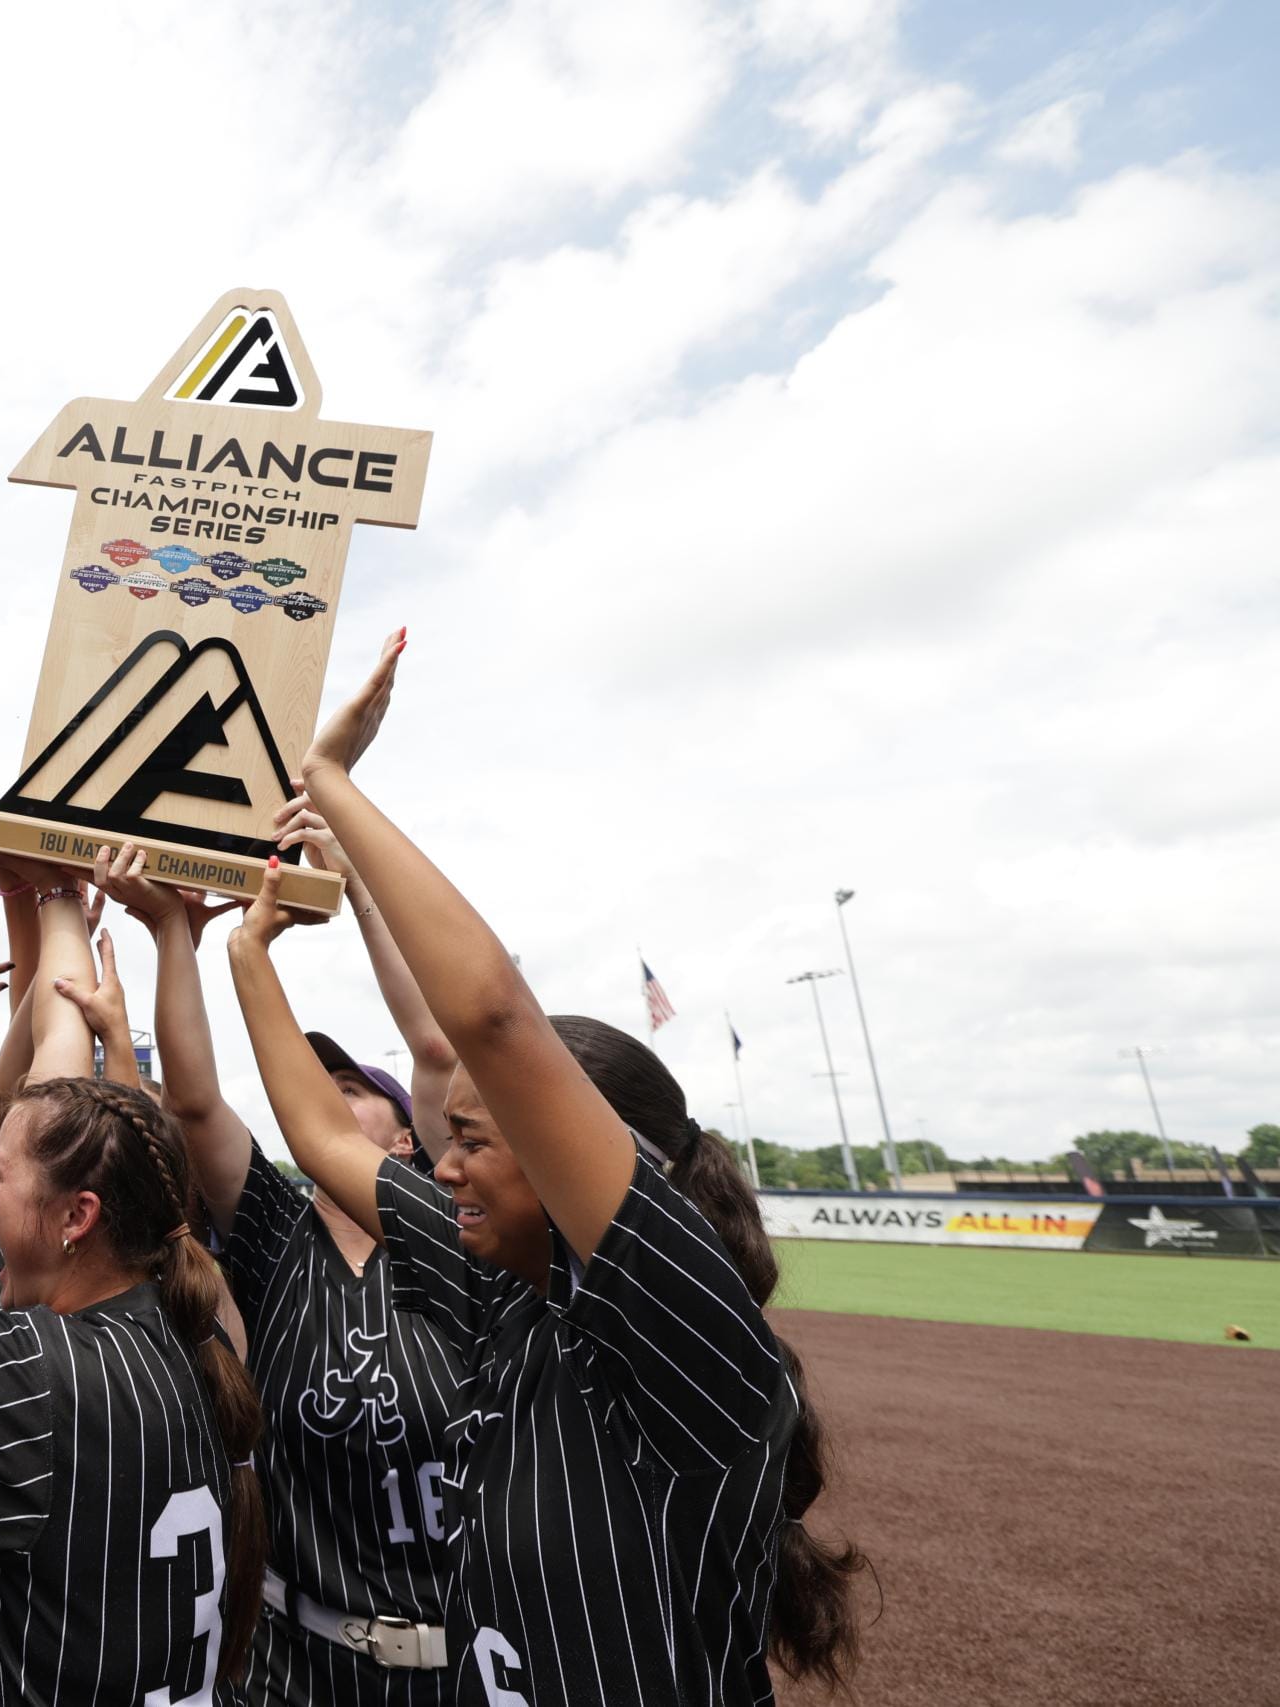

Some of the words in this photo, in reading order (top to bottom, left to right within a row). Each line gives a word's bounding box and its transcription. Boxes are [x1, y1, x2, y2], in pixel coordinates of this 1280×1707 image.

[57, 423, 398, 493] ALLIANCE
[134, 473, 301, 502] FASTPITCH
[91, 487, 339, 531] CHAMPIONSHIP
[150, 515, 266, 545] SERIES
[73, 571, 118, 582] FASTPITCH
[205, 558, 251, 569] AMERICA
[256, 565, 304, 576] FASTPITCH
[39, 831, 68, 853] 18U
[157, 853, 247, 888] CHAMPION
[811, 1206, 943, 1229] ALWAYS
[956, 1211, 1020, 1232] ALL
[1030, 1213, 1068, 1233] IN
[144, 1484, 226, 1707] 3
